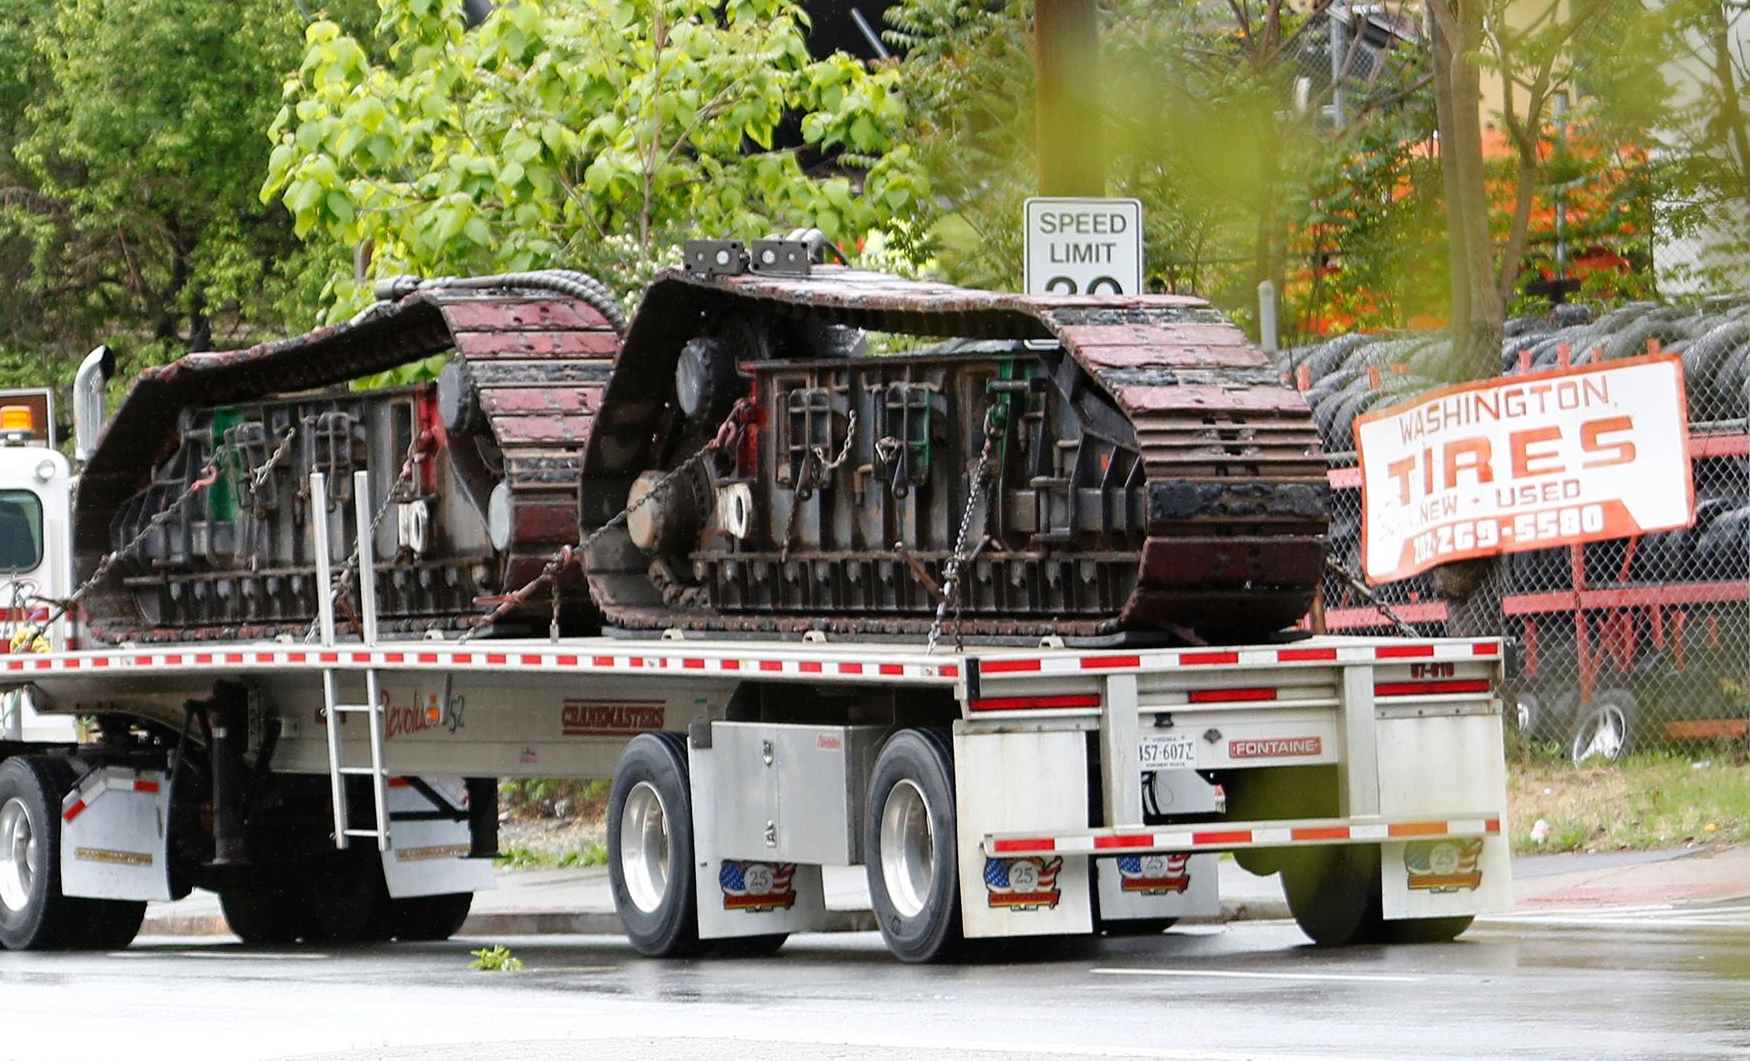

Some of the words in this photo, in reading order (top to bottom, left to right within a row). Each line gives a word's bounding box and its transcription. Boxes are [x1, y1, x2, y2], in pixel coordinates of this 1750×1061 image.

[1039, 212, 1127, 234] SPEED
[1050, 242, 1117, 263] LIMIT
[1399, 376, 1610, 445] WASHINGTON
[1388, 414, 1637, 506] TIRES
[1419, 494, 1458, 524] NEW
[1495, 478, 1581, 508] USED
[1412, 504, 1605, 565] 202-269-5580
[1236, 739, 1316, 755] FONTAINE
[748, 869, 769, 887] 25
[1013, 867, 1034, 885] 25
